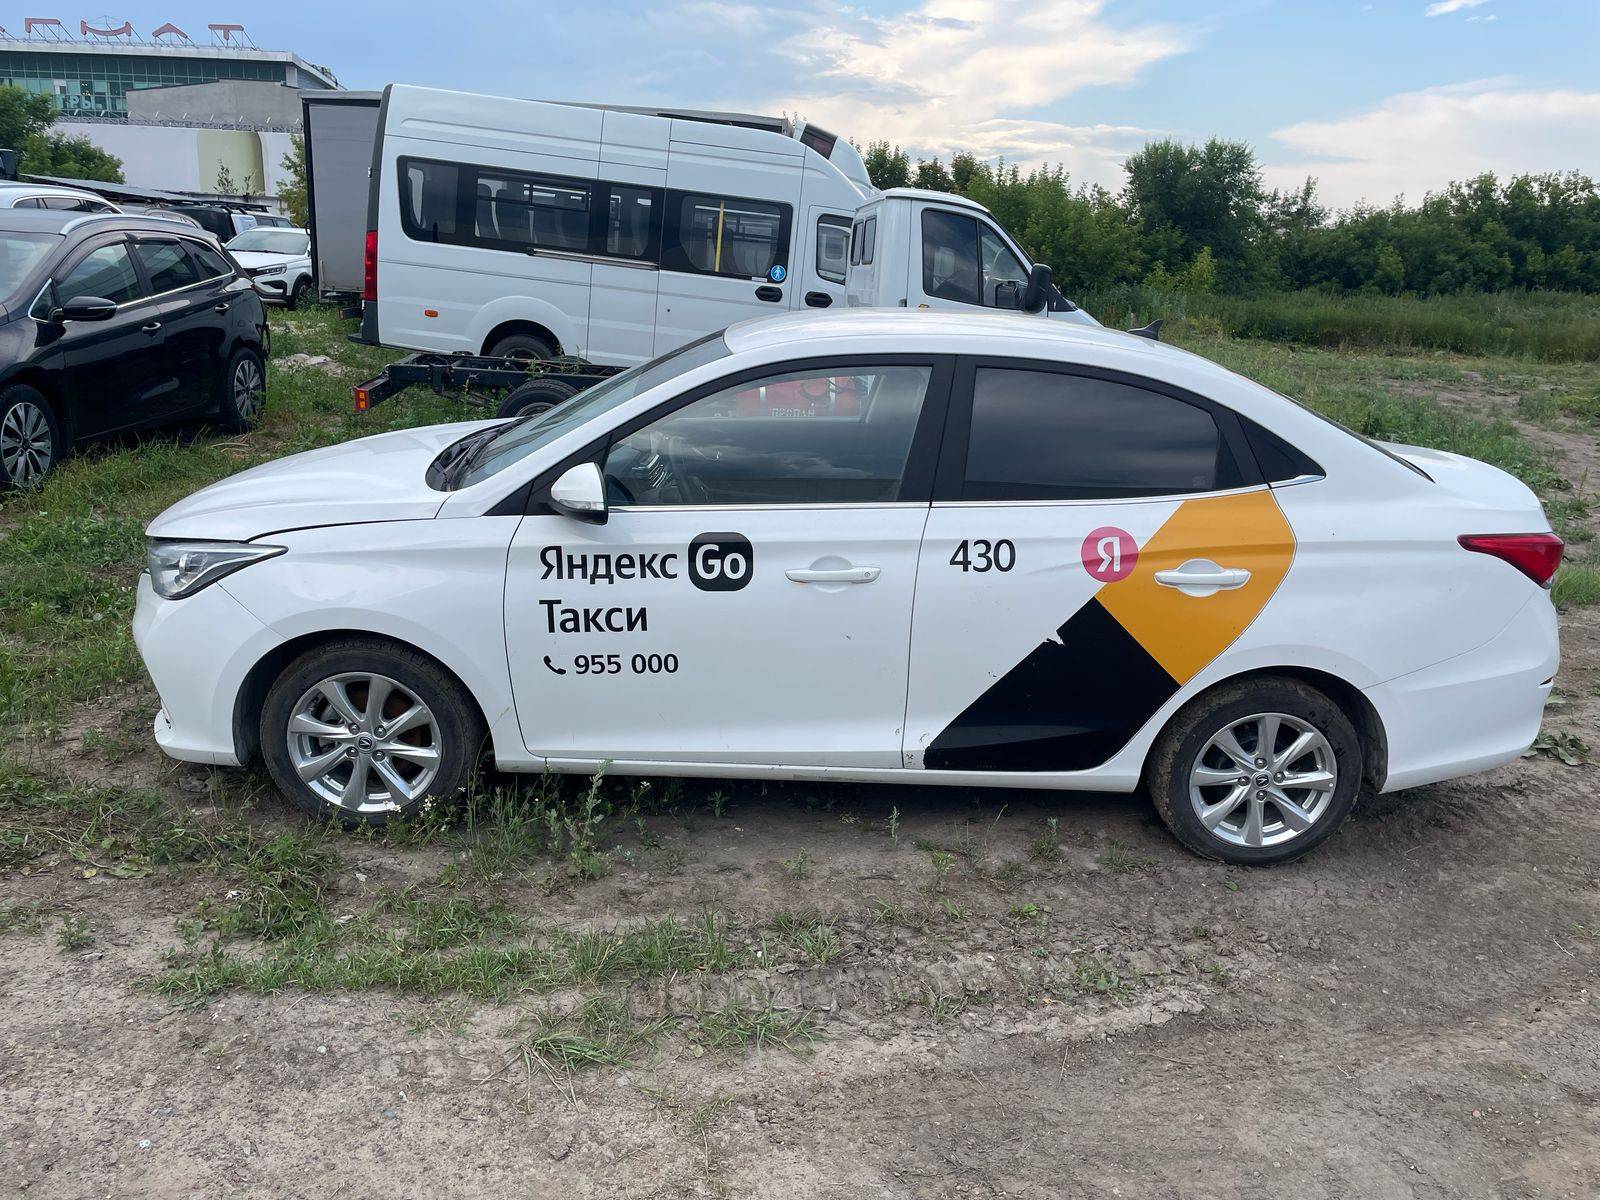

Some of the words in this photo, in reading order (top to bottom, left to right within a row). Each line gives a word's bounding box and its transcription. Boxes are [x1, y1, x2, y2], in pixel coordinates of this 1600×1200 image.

[540, 545, 678, 584] Яндекс
[695, 544, 747, 580] Go
[949, 538, 1016, 573] 430
[1096, 536, 1121, 573] Я
[538, 599, 648, 634] Такси
[573, 654, 622, 675] 955
[631, 653, 679, 674] 000
